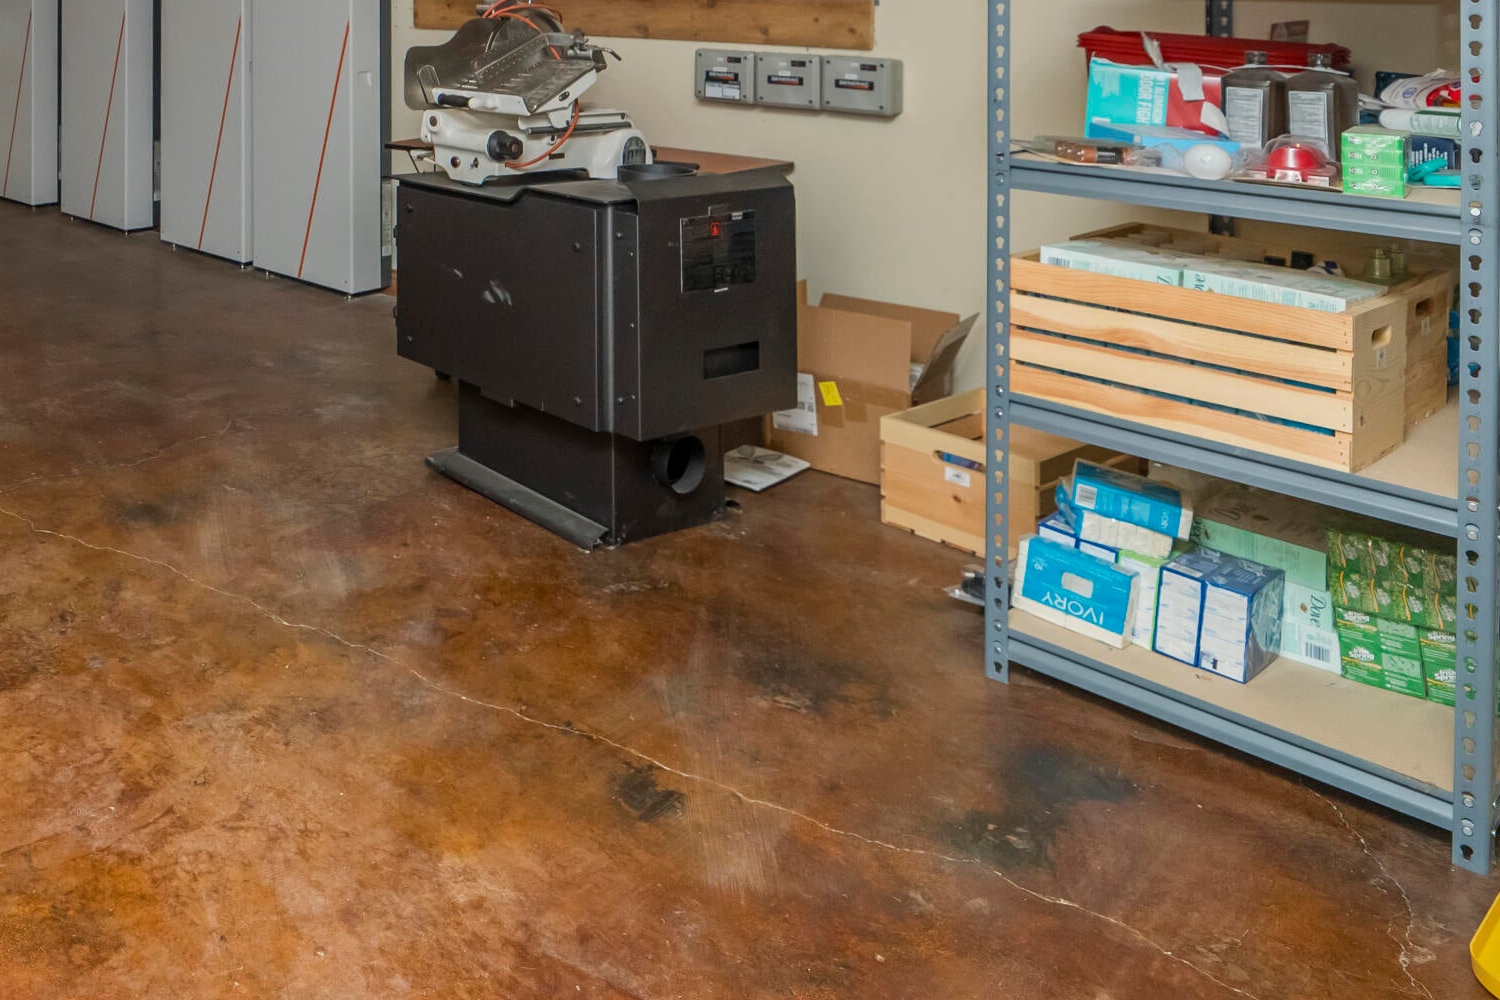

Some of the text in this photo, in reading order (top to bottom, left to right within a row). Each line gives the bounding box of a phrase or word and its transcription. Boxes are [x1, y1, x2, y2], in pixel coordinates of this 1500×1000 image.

[1042, 591, 1104, 625] IVORY
[1308, 594, 1327, 629] Dove
[1434, 673, 1457, 682] Sprin
